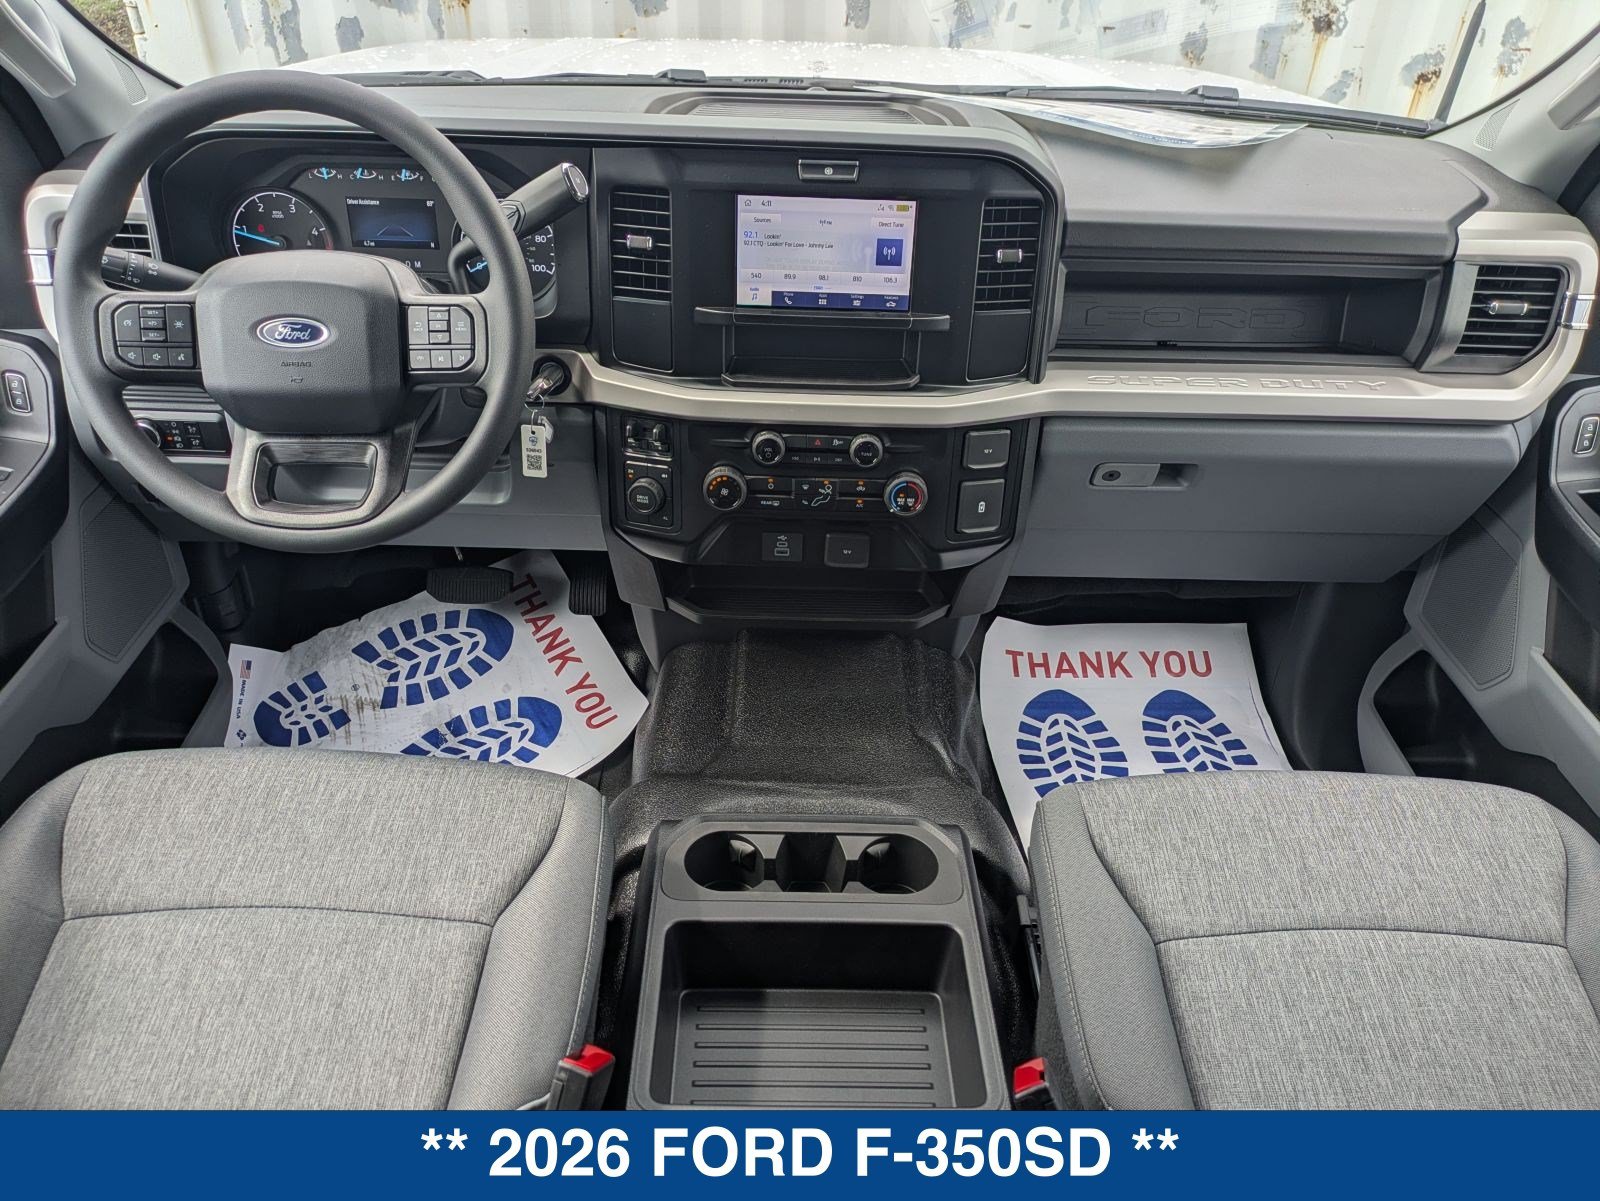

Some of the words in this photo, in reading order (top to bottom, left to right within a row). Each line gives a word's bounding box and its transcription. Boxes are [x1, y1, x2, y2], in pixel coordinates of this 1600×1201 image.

[258, 203, 265, 212] 2
[289, 204, 296, 213] 3
[753, 216, 772, 224] Sources
[311, 227, 319, 236] 4
[743, 231, 759, 239] 92.1
[535, 235, 547, 243] 80
[415, 260, 422, 268] M
[531, 264, 547, 272] 100
[1084, 304, 1306, 330] FORD
[274, 323, 311, 342] Ford
[280, 360, 312, 368] AIRBAG
[1087, 374, 1249, 390] SUPER
[1258, 376, 1388, 392] DUTY
[511, 573, 583, 677] THANK
[565, 671, 618, 730] YOU
[1005, 649, 1134, 679] THANK
[1138, 649, 1213, 678] YOU
